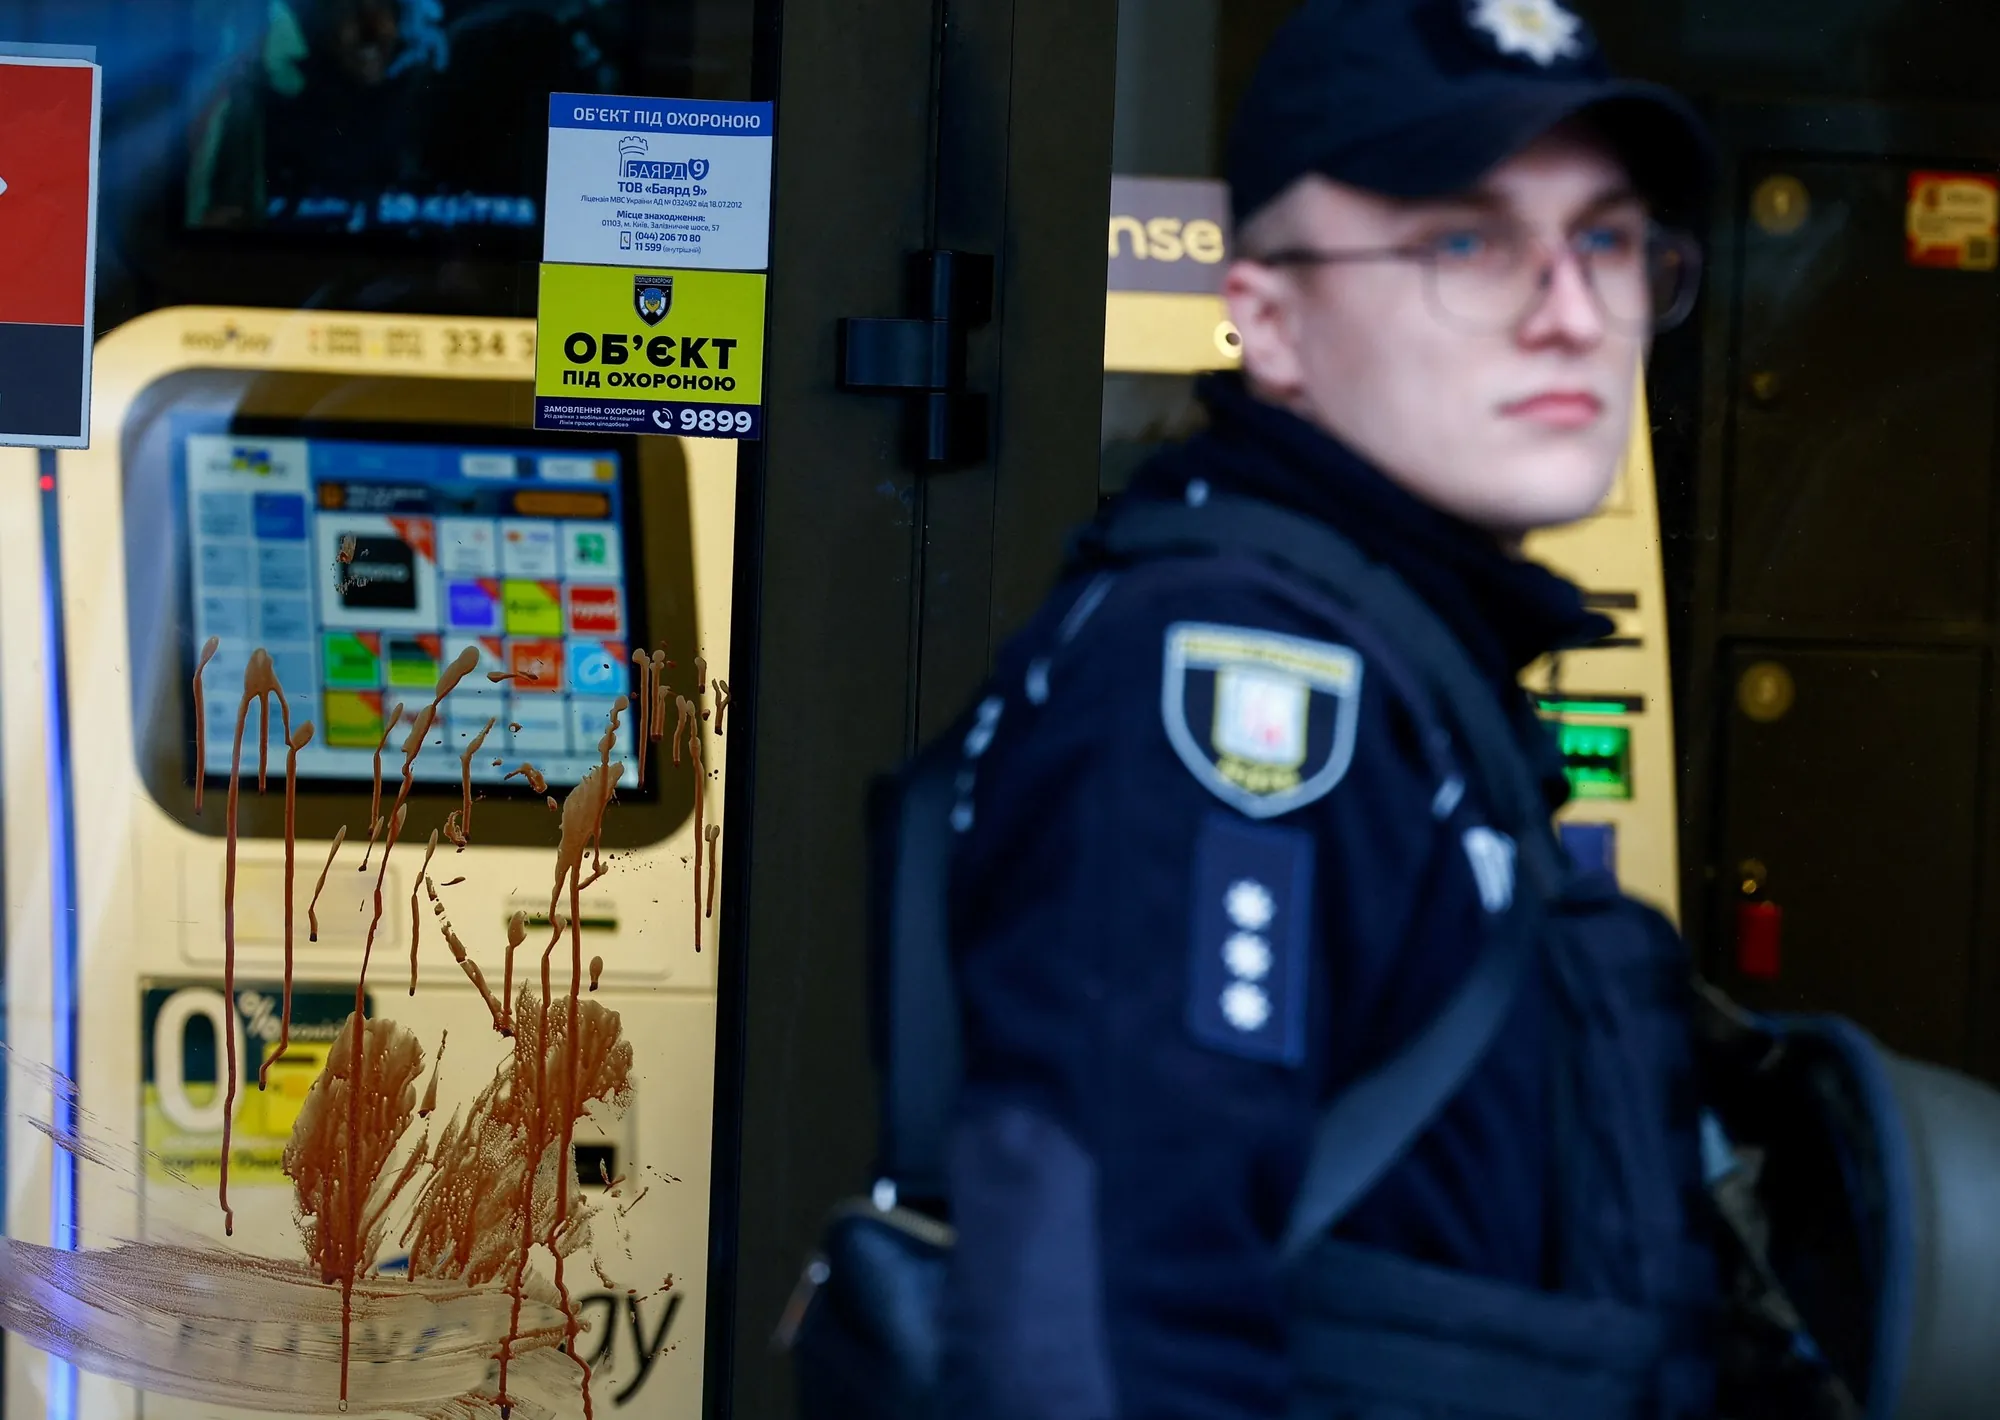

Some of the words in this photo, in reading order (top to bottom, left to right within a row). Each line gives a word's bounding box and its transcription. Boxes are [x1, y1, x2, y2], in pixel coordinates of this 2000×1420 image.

[573, 107, 630, 123] ОБ’ЄКТ
[633, 110, 662, 127] ПІД
[666, 112, 760, 129] ОХОРОНОЮ
[628, 161, 686, 180] БАЯРД
[618, 182, 642, 193] ТОВ
[645, 183, 690, 197] «Баярд
[693, 185, 707, 196] 9»
[581, 195, 609, 204] Ліцензія
[610, 196, 625, 204] МВС
[626, 197, 652, 206] України
[653, 199, 663, 207] АД
[709, 201, 742, 209] 18.07.2012
[616, 210, 643, 220] Місце
[644, 213, 706, 223] знаходження:
[602, 220, 623, 228] 01103,
[651, 222, 689, 231] Залізничне
[690, 224, 710, 232] шосе,
[635, 232, 658, 242] (044)
[660, 233, 675, 242] 206
[677, 234, 687, 242] 70
[688, 234, 701, 243] 80
[635, 242, 642, 251] 11
[644, 242, 661, 252] 599
[564, 332, 737, 369] ОБ’ЄКТ
[563, 370, 601, 388] ПІД
[607, 372, 736, 391] ОХОРОНОЮ
[544, 405, 601, 414] ЗАМОВЛЕННЯ
[604, 408, 645, 416] ОХОРОНИ
[680, 408, 752, 433] 9899
